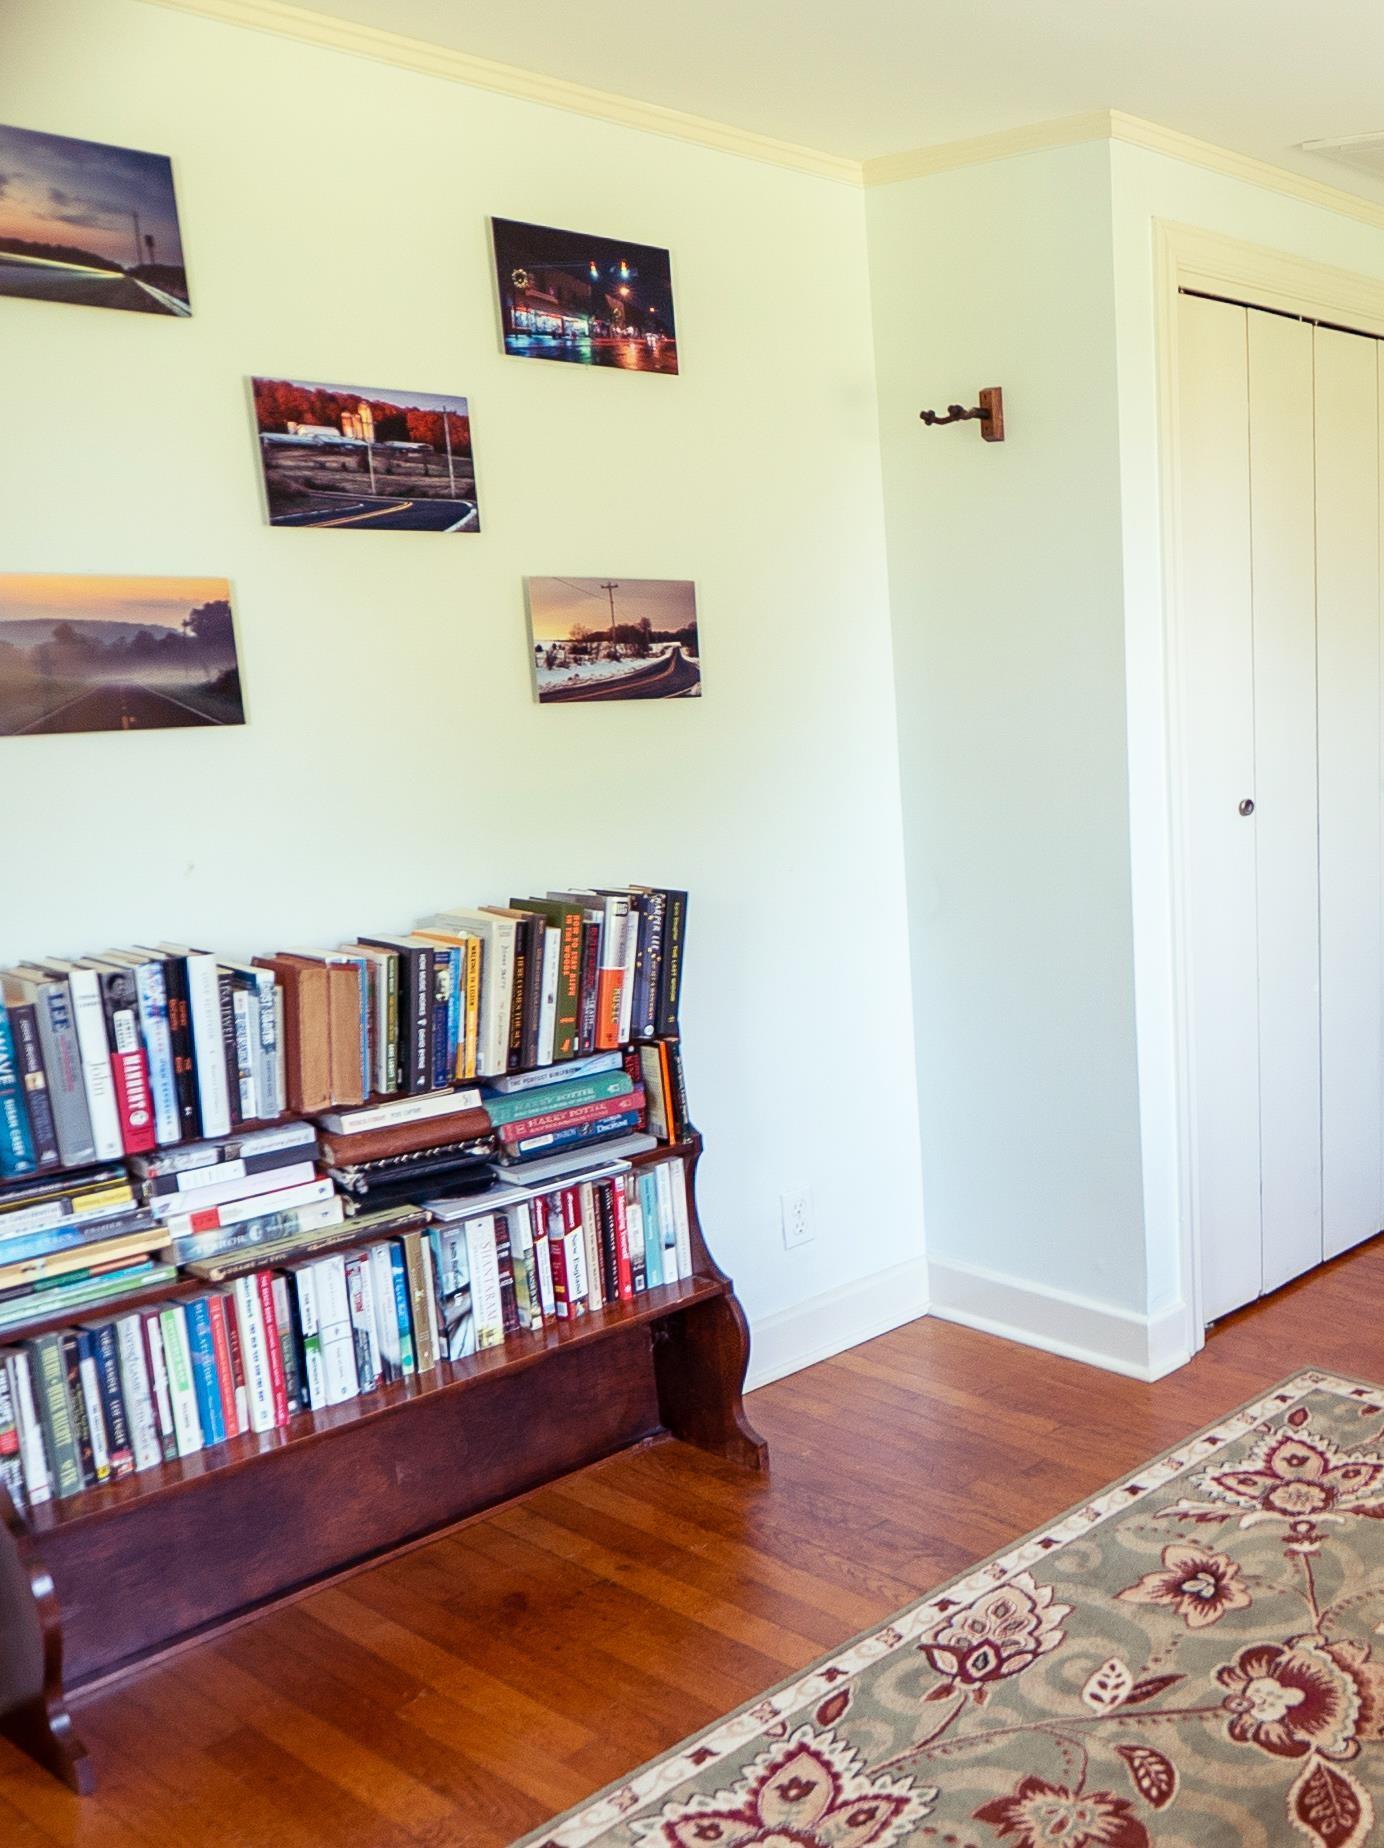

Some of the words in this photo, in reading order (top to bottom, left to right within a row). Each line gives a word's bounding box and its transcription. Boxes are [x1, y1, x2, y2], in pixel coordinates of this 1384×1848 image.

[572, 914, 581, 935] HOW
[651, 897, 664, 932] HARPER
[571, 938, 579, 948] TO
[650, 935, 661, 953] LEE
[418, 954, 426, 970] HOW
[219, 979, 231, 1003] LISA
[418, 971, 426, 992] MUSIC
[47, 992, 71, 1033] LEE
[611, 987, 621, 1024] MUSIC
[221, 1005, 234, 1044] JEWELL
[87, 1061, 110, 1097] John
[122, 1054, 146, 1109] MANHUNT
[4, 1099, 18, 1129] SUSAN
[528, 1113, 567, 1128] HARRY
[568, 1104, 607, 1117] POTTER
[617, 1195, 626, 1230] Managing
[571, 1234, 579, 1255] New
[479, 1241, 497, 1321] SHANTARAM
[571, 1258, 582, 1295] England
[303, 1293, 311, 1305] THE
[305, 1307, 313, 1331] WORLD
[311, 1357, 319, 1386] WITHOUT
